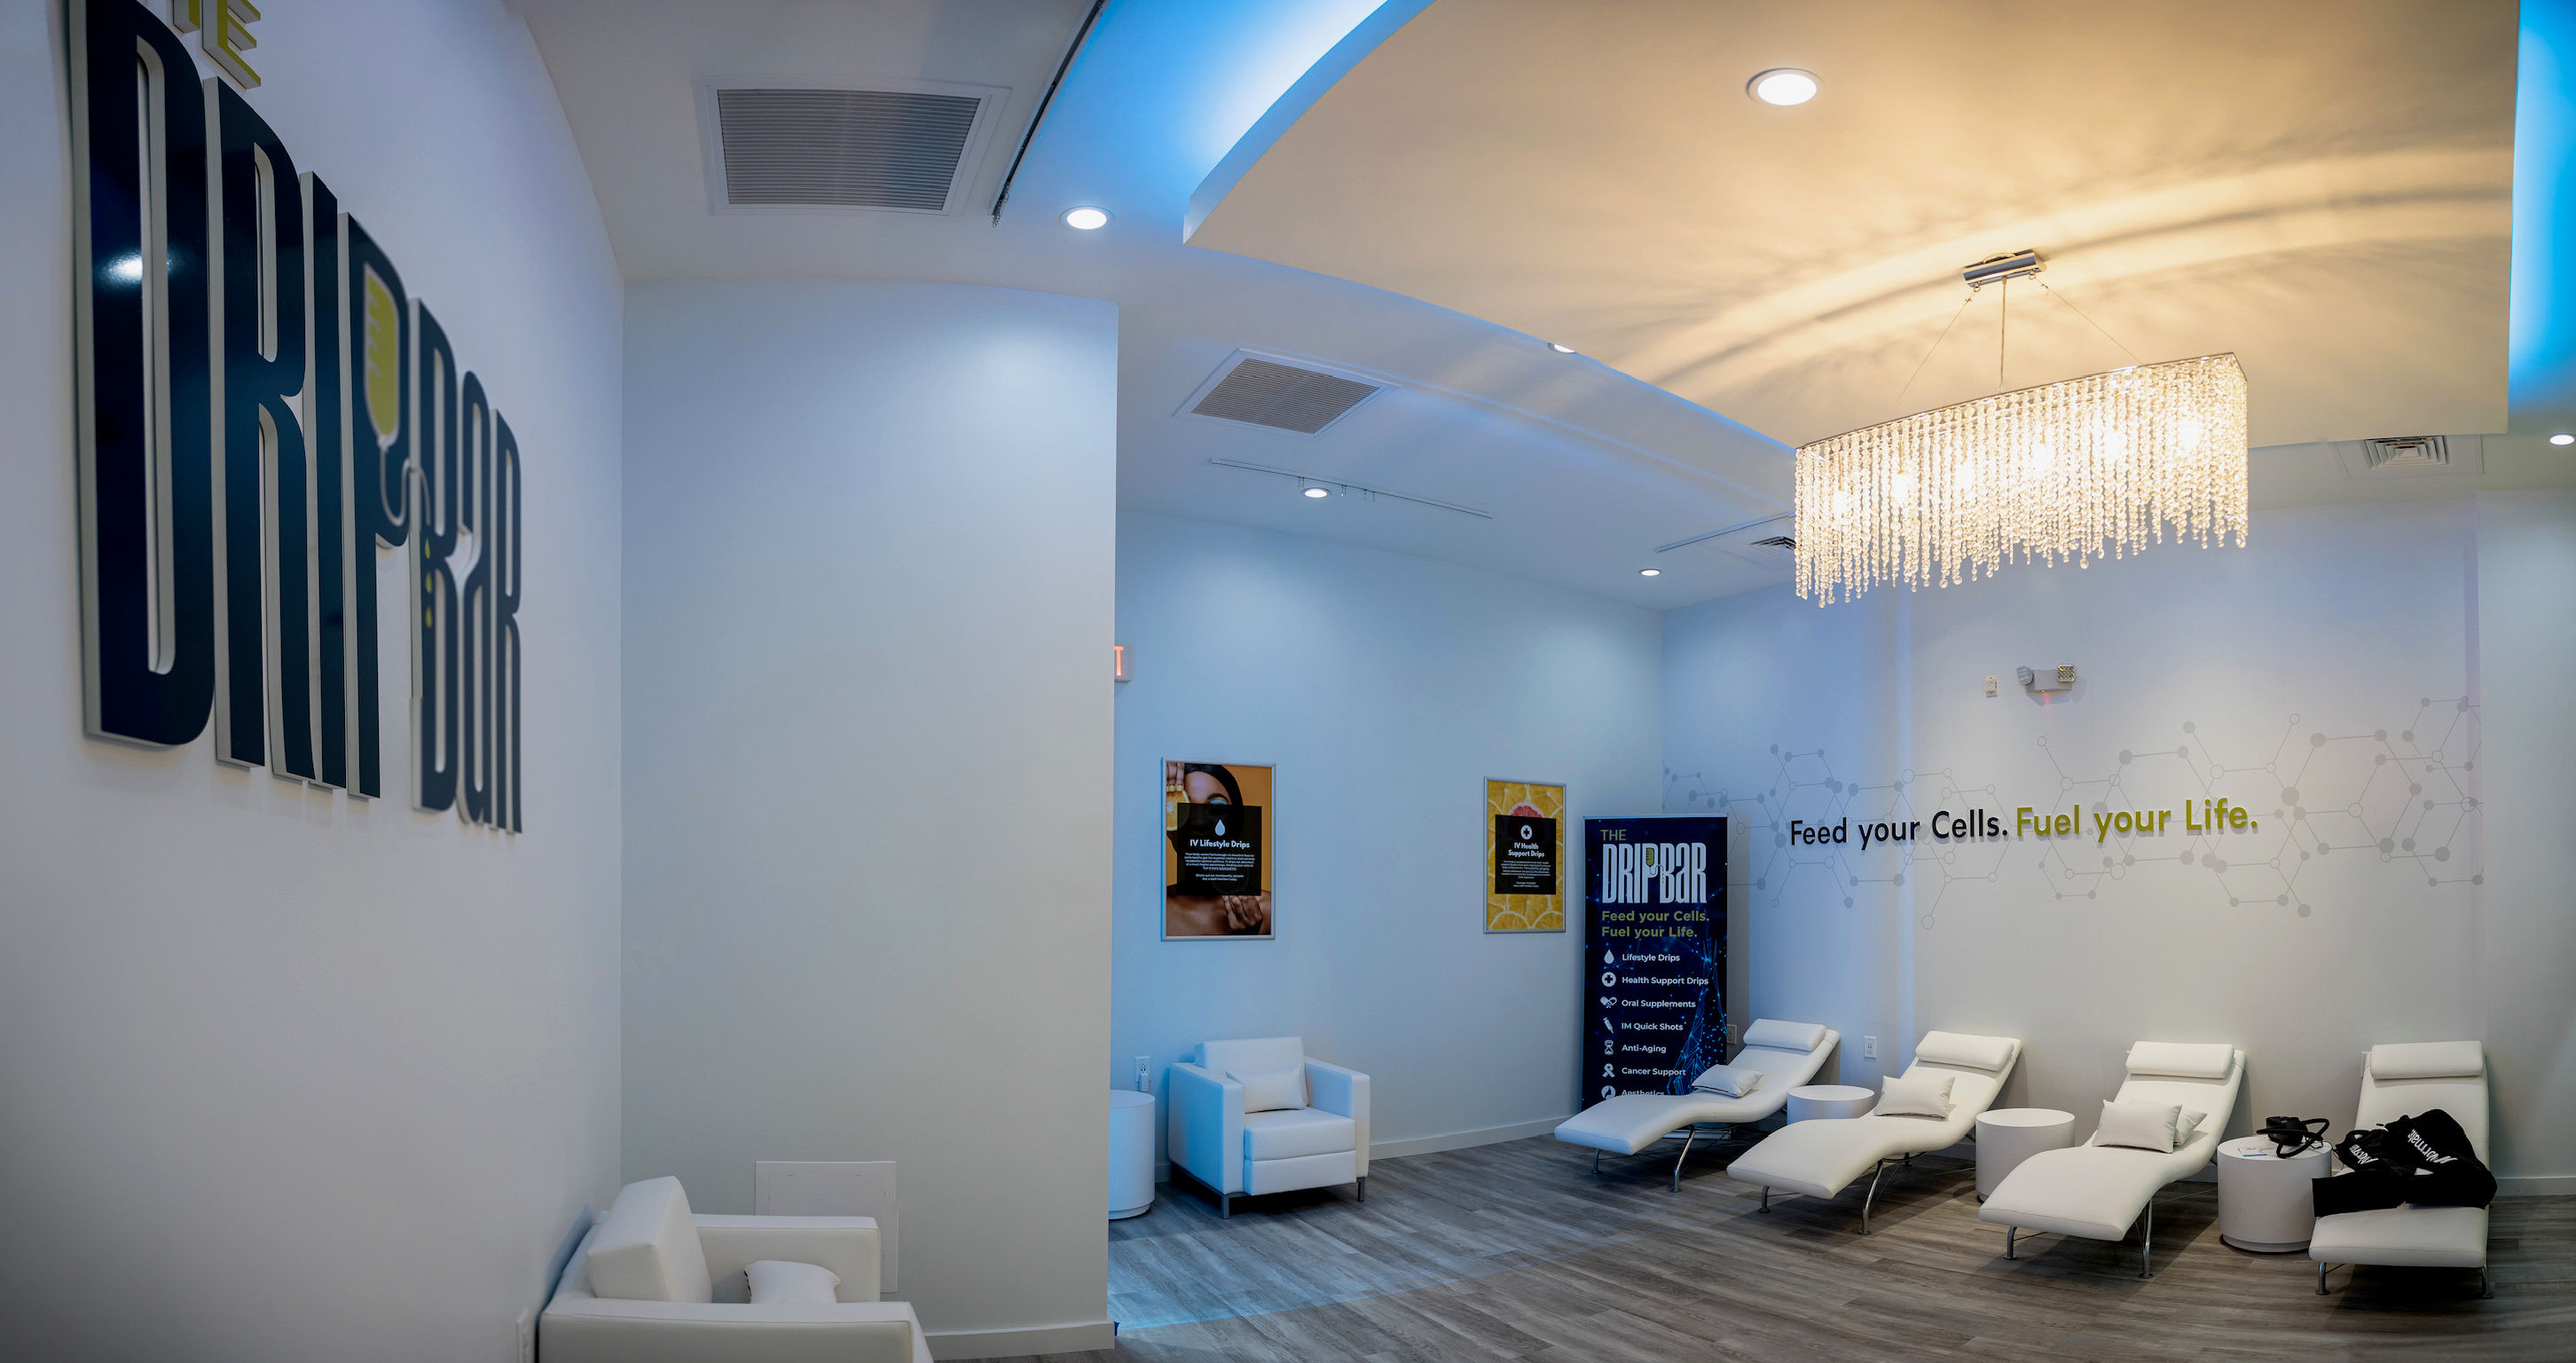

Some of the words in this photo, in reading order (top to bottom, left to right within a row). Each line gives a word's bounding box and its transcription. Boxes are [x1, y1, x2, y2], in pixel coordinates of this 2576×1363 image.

[1790, 817, 1848, 845] Feed
[1858, 821, 1920, 850] your
[1931, 808, 2008, 839] Cells.
[2017, 805, 2080, 836] Fuel
[2093, 806, 2171, 843] your
[2186, 798, 2258, 832] Life.
[1600, 829, 1627, 841] THE
[1199, 839, 1230, 849] Lifestyle
[1230, 839, 1251, 850] Drips
[1507, 849, 1530, 858] Support
[1602, 910, 1635, 921] Feed
[1639, 912, 1669, 924] your
[1673, 910, 1710, 922] Cells.
[1601, 926, 1630, 937] Fuel
[1634, 928, 1664, 939] your
[1669, 926, 1698, 937] Life.
[1622, 953, 1656, 963] Lifestyle
[1658, 954, 1681, 963] Drips
[1651, 976, 1685, 986] Support
[1686, 977, 1709, 986] Drips
[1640, 999, 1696, 1009] Supplements
[1633, 1022, 1658, 1031] Quick
[1660, 1022, 1684, 1031] Shots
[1622, 1044, 1667, 1053] Anti-Aging
[1652, 1068, 1686, 1077] Support
